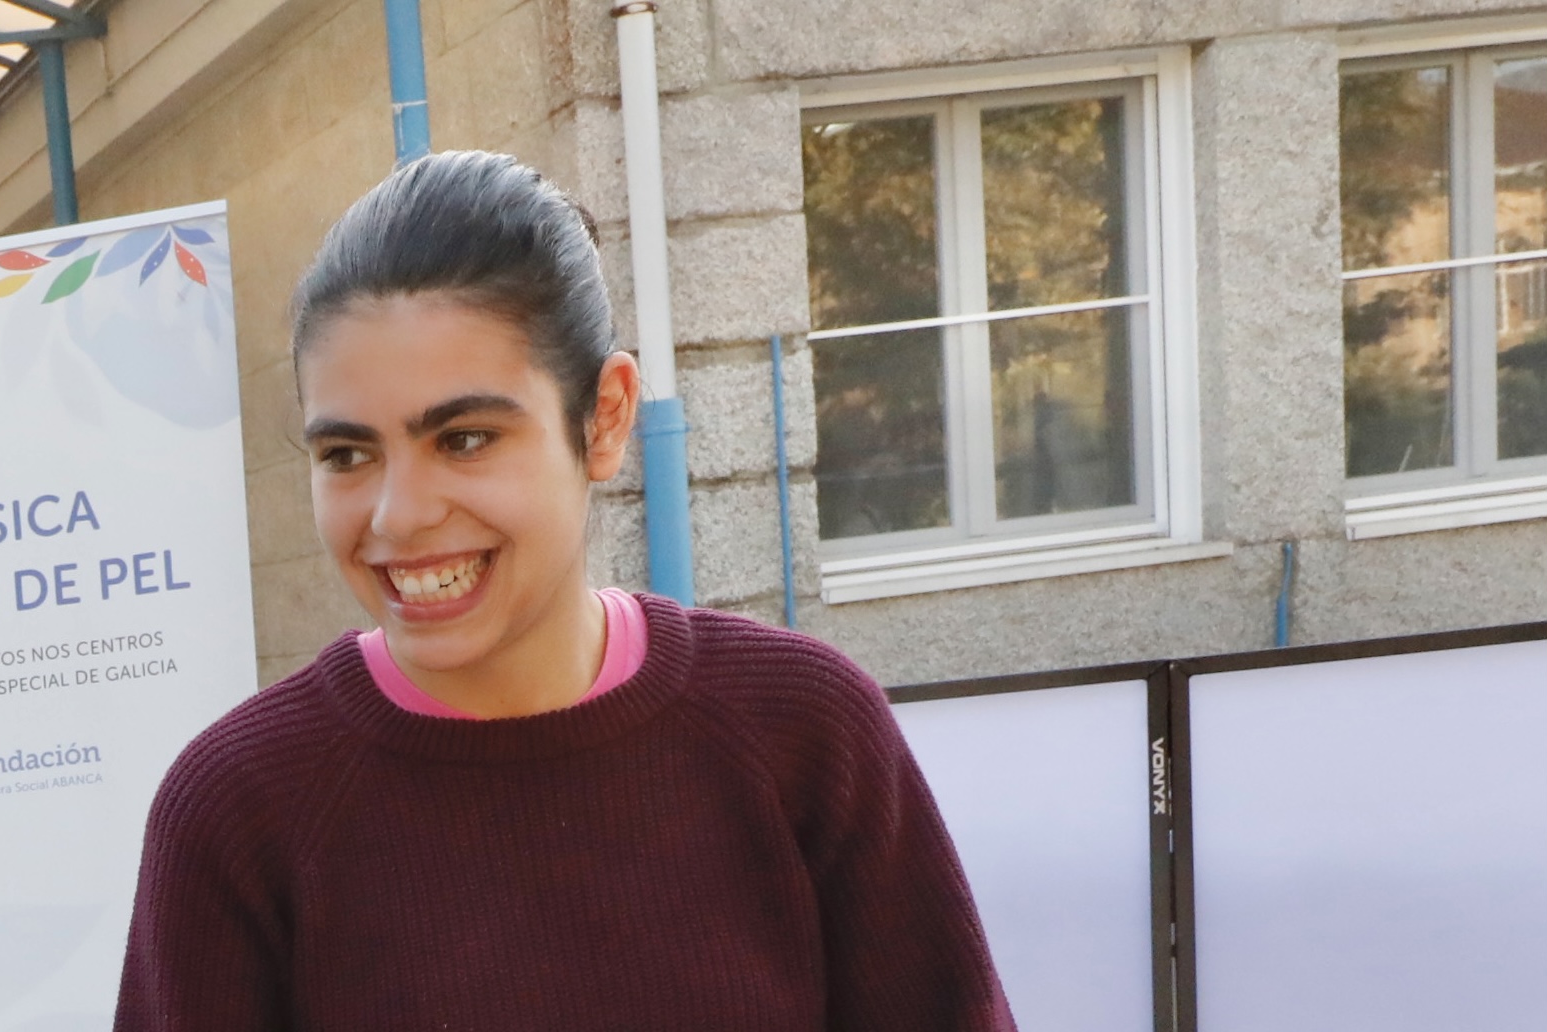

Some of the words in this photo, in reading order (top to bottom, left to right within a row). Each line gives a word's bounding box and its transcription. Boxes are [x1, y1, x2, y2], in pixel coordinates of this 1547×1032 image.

[14, 563, 82, 612] DE
[99, 549, 192, 601] PEL
[31, 643, 71, 663] NOS
[76, 631, 164, 657] CENTROS
[75, 668, 100, 686] DE
[105, 658, 178, 682] GALICIA
[15, 778, 49, 793] Social
[52, 772, 103, 789] ABANCA
[1152, 737, 1166, 815] VONYX
